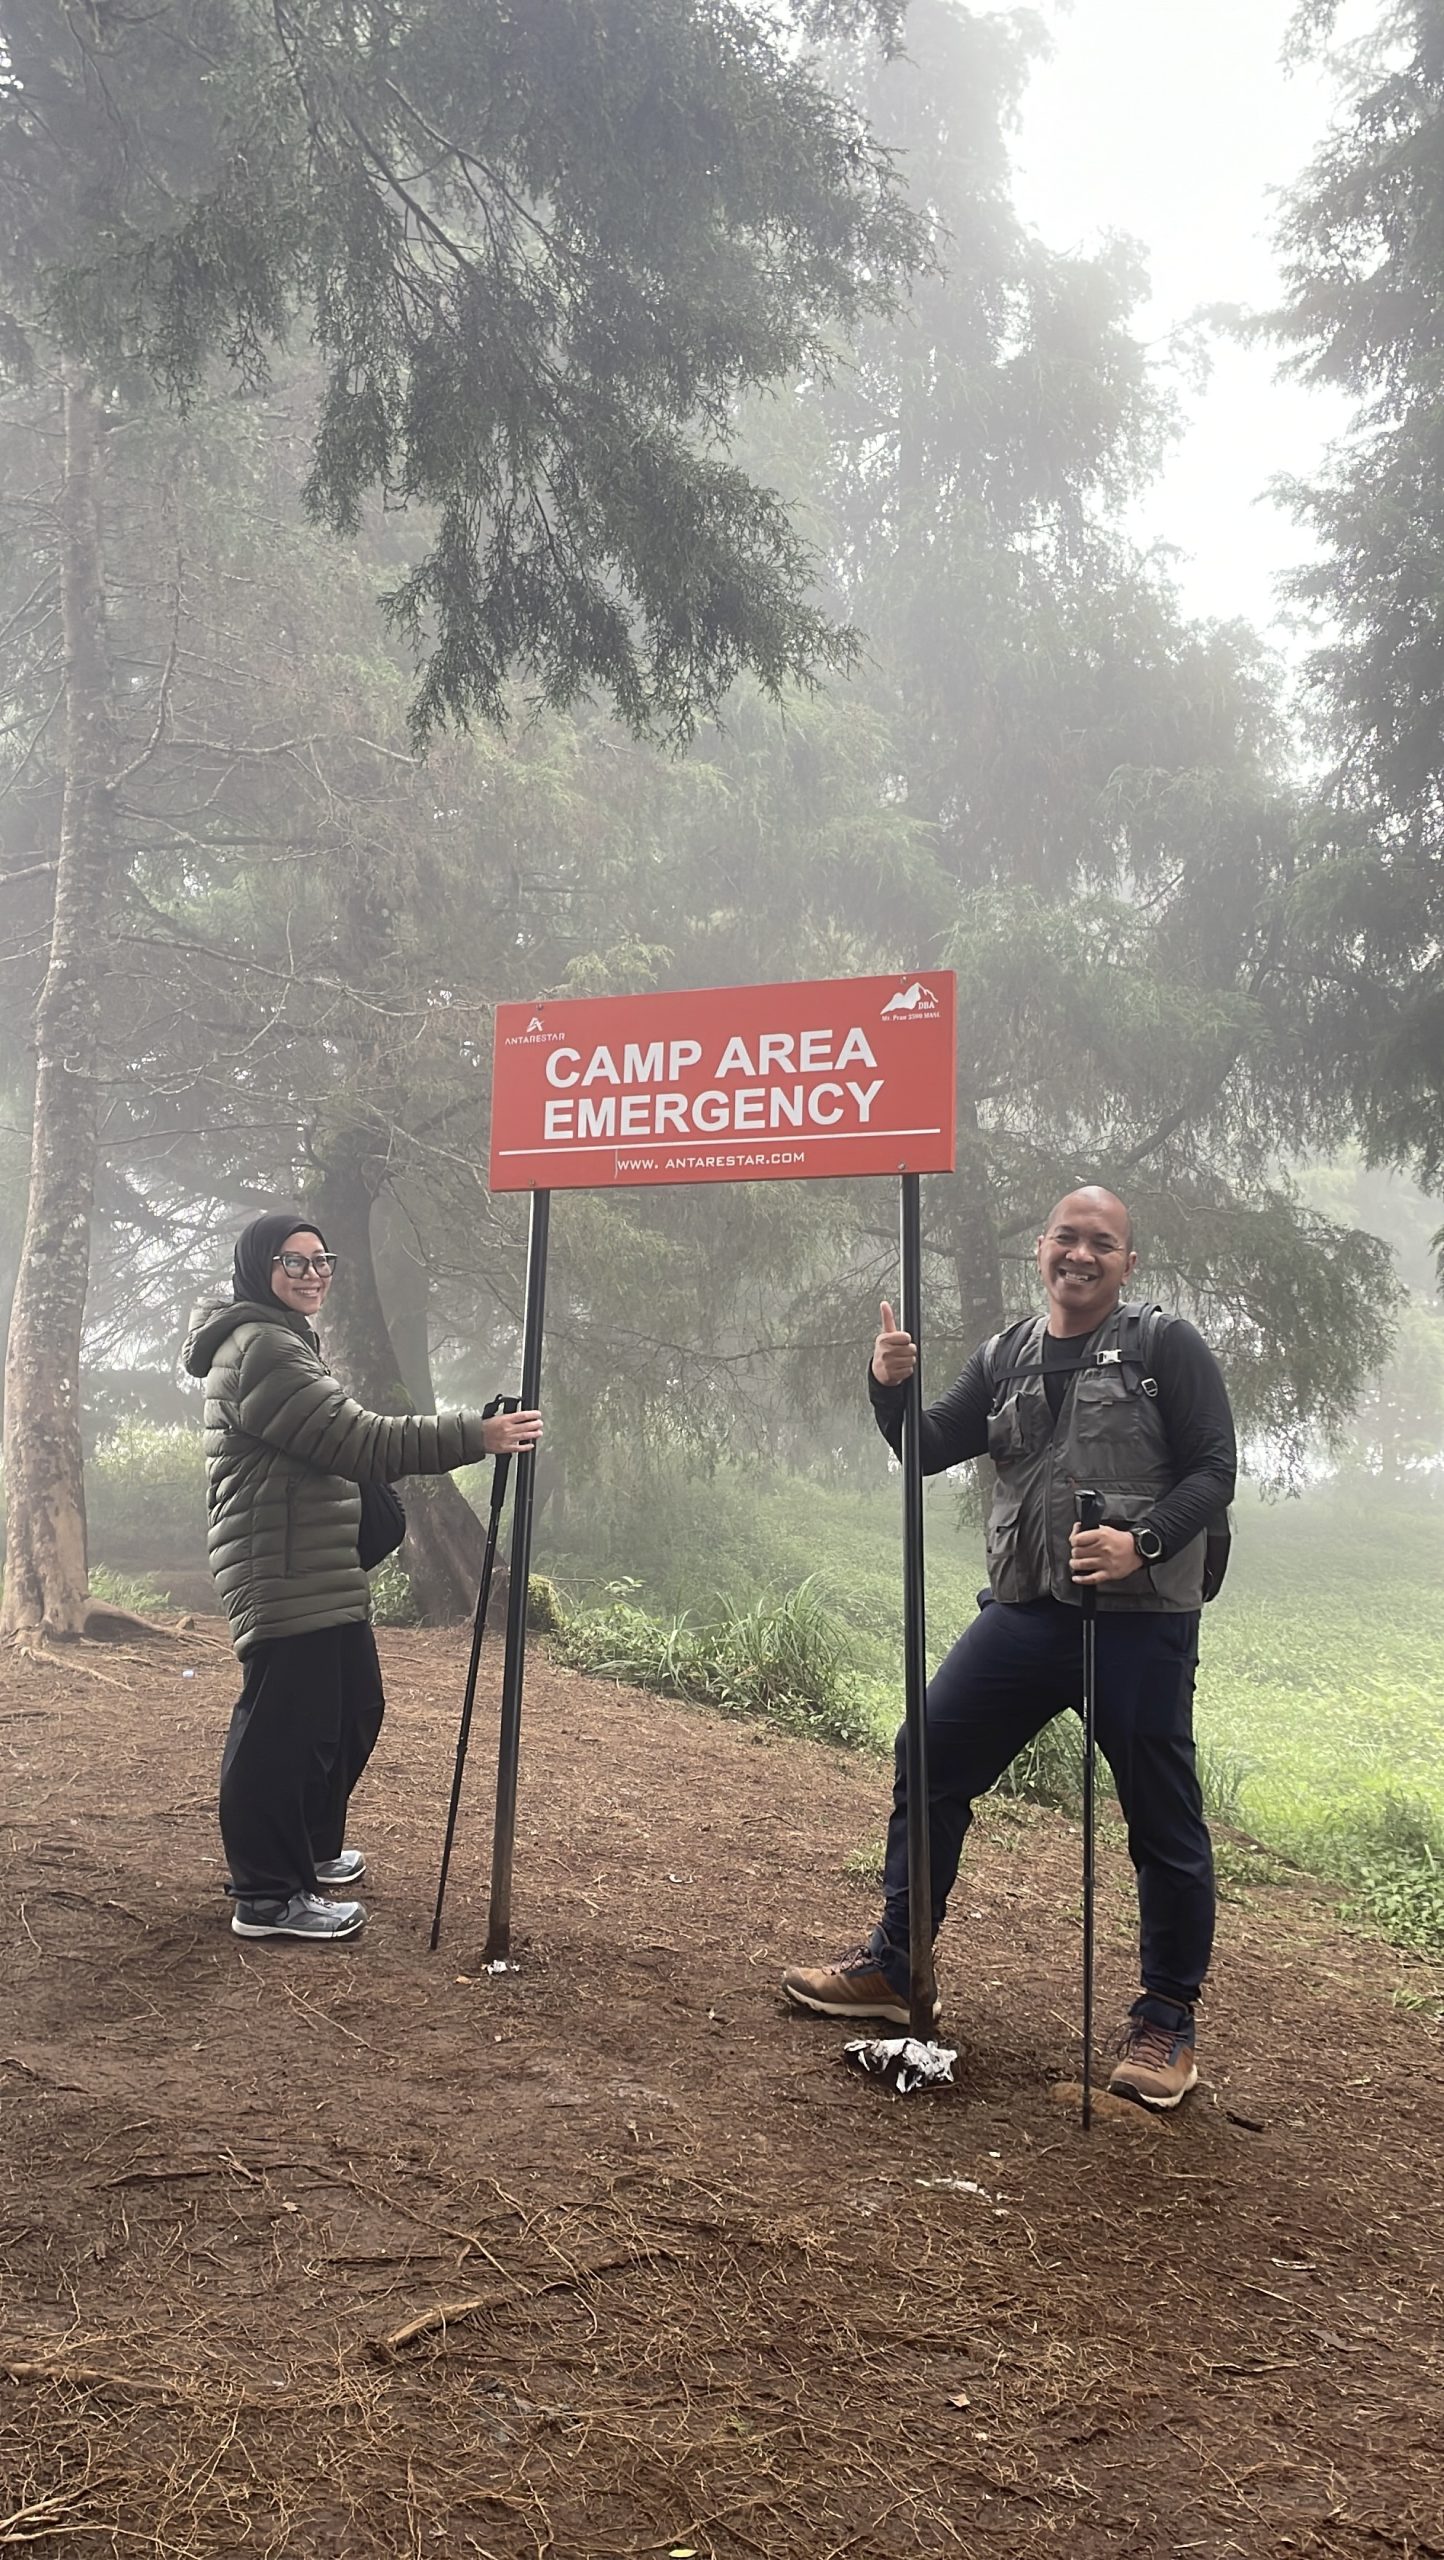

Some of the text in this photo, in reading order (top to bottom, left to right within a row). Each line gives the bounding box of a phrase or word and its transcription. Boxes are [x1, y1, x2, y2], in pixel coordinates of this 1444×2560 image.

[505, 1032, 566, 1045] ANTARESTAR
[545, 1027, 878, 1088] CAMP AREA
[544, 1080, 885, 1140] EMERGENCY
[665, 1152, 805, 1169] ANTARESTAR.COM
